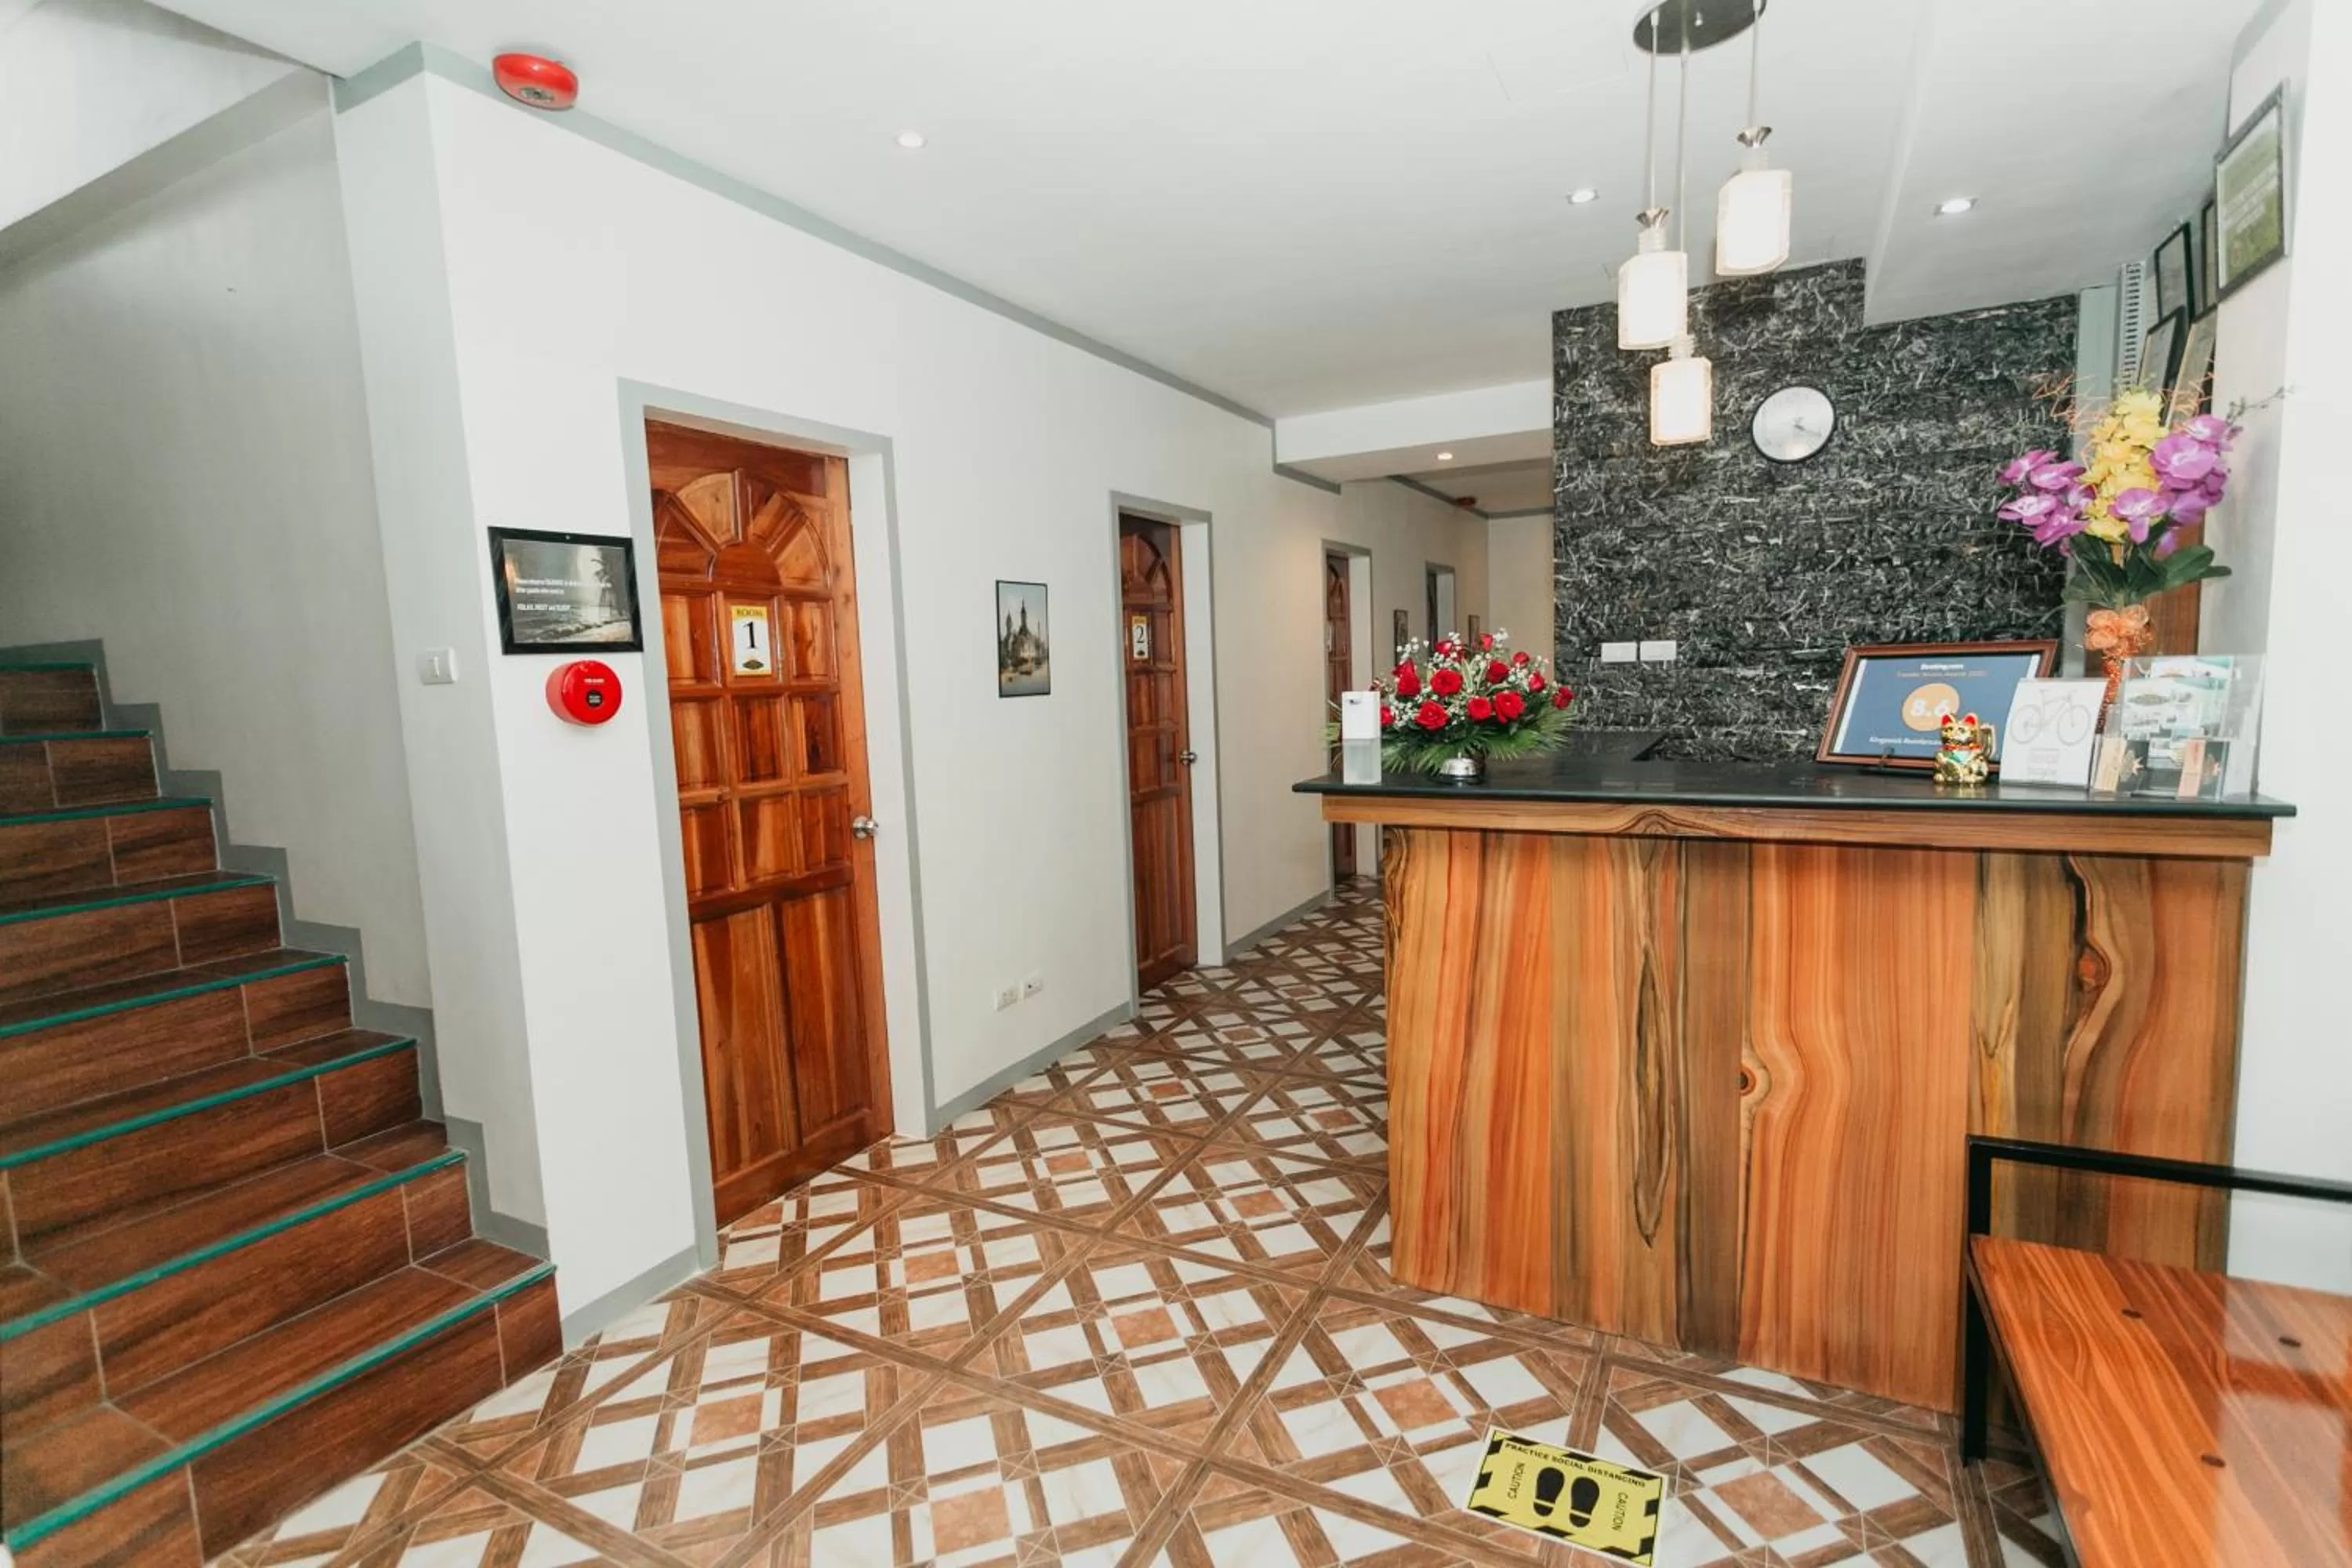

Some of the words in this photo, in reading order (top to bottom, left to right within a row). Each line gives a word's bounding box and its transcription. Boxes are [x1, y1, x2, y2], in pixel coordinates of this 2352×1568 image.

[742, 621, 759, 649] 1
[1136, 626, 1145, 644] 2
[1909, 699, 1951, 717] 8.6
[1504, 1443, 1549, 1460] PRACTICE
[1552, 1455, 1584, 1470] SOCIAL
[1588, 1465, 1646, 1488] DISTANCING
[1507, 1461, 1525, 1500] CAUTION
[1611, 1491, 1628, 1532] CAUTION
